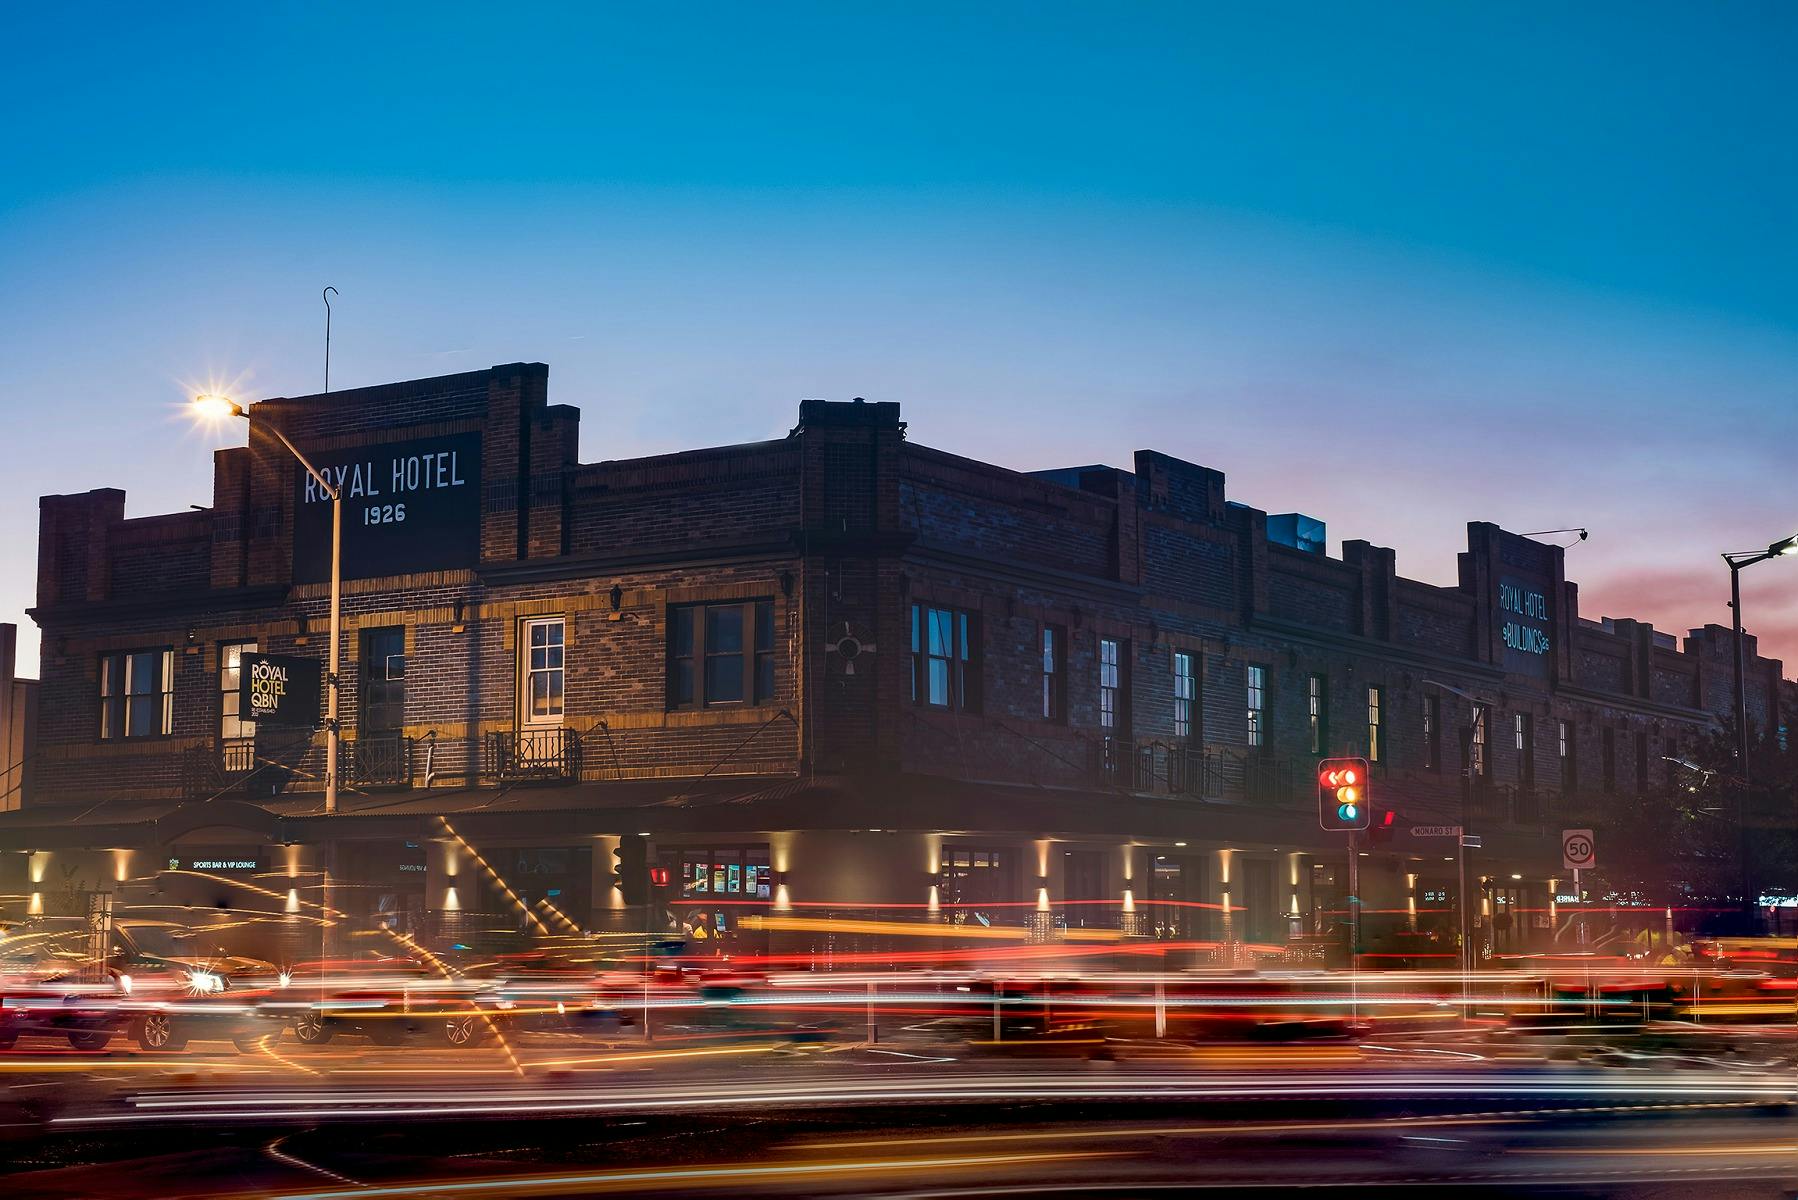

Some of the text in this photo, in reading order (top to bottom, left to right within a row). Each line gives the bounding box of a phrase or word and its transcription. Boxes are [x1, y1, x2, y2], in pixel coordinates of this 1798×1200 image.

[305, 451, 465, 503] ROYAL HOTEL
[364, 503, 406, 526] 1926
[1501, 584, 1547, 620] ROYAL HOTEL
[1507, 622, 1542, 655] BUILDINGS
[252, 664, 288, 681] ROYAL
[252, 679, 286, 695] HOTEL
[251, 692, 278, 709] QBN
[1415, 827, 1453, 835] MONARO ST
[1570, 842, 1589, 856] 50
